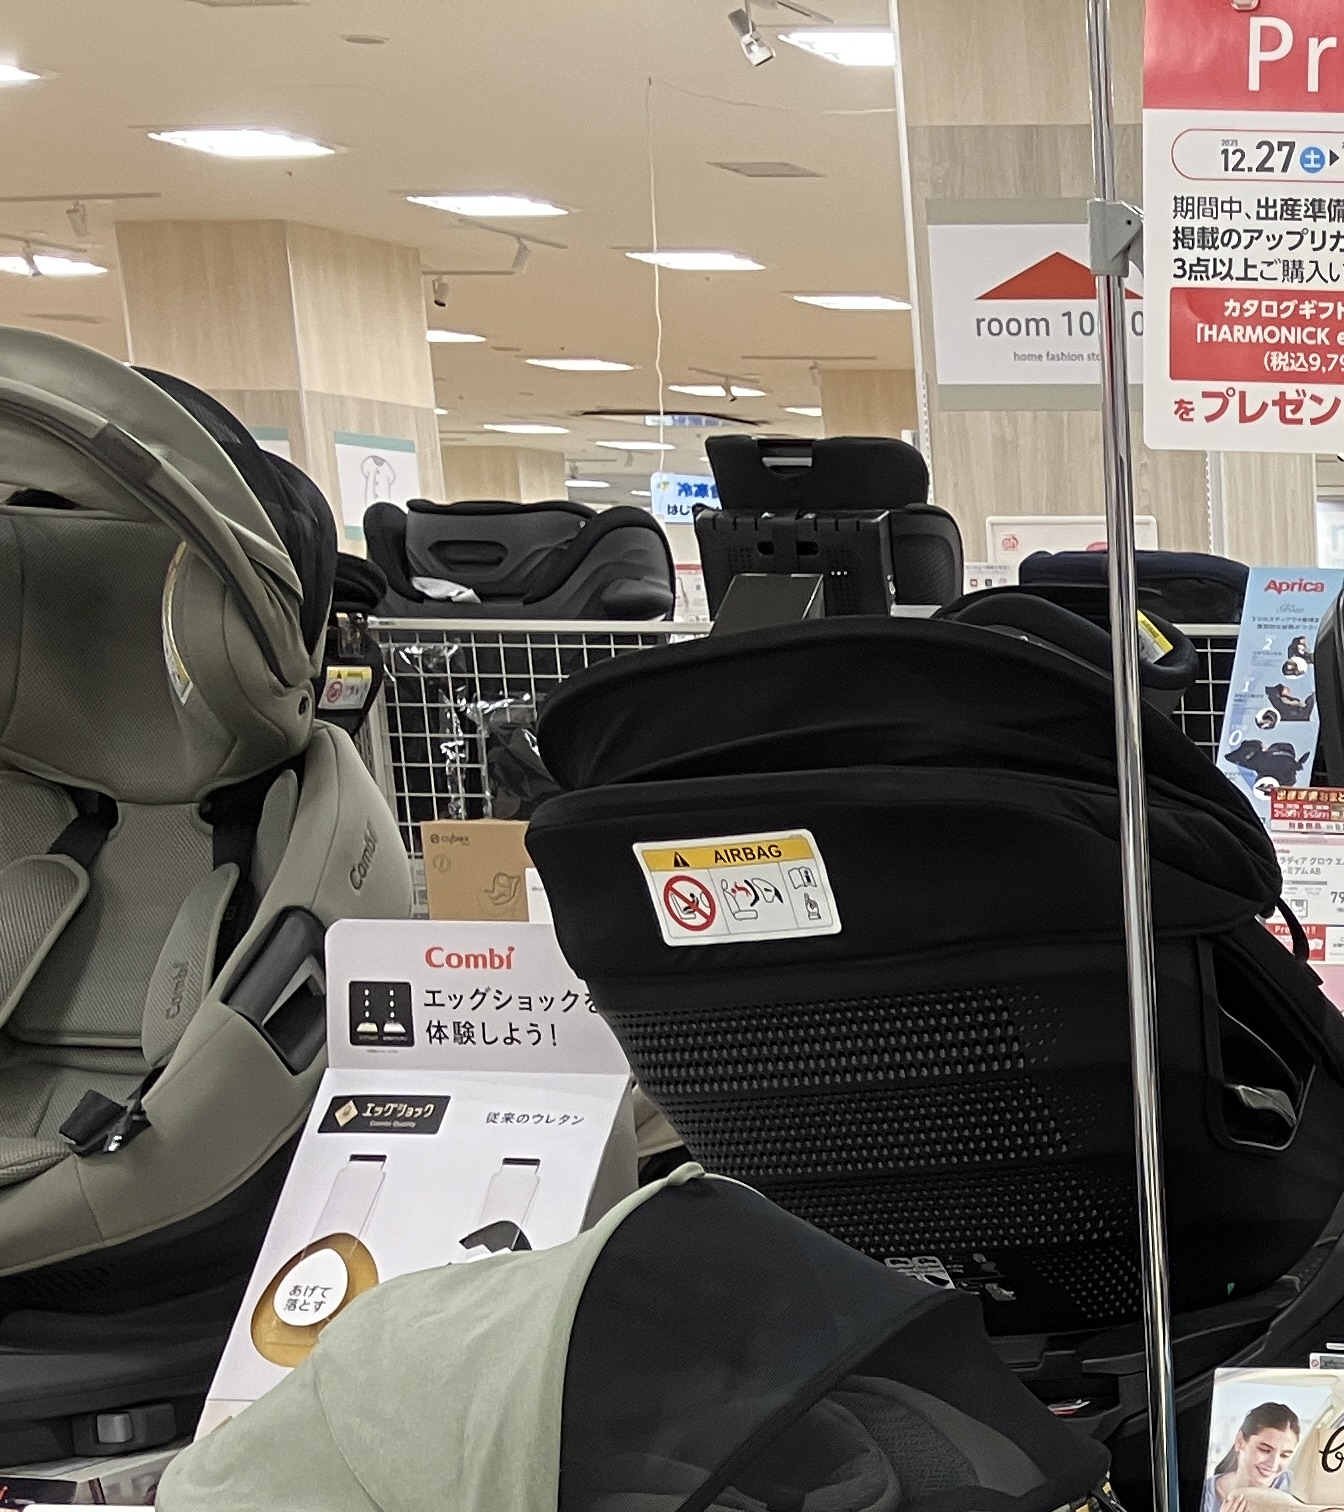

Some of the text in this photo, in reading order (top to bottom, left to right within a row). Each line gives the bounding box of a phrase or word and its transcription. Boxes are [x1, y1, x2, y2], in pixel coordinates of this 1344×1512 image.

[976, 317, 1050, 337] room
[1014, 352, 1084, 362] home fashion
[1264, 577, 1324, 595] Aprica
[348, 827, 379, 892] Combi
[712, 843, 784, 866] AIRBAG
[424, 945, 516, 971] Combi
[425, 1019, 558, 1047] 体験しよう!
[485, 1111, 585, 1128] 従来のウレタン
[289, 1283, 333, 1299] あげて
[283, 1298, 326, 1314] 落とす
